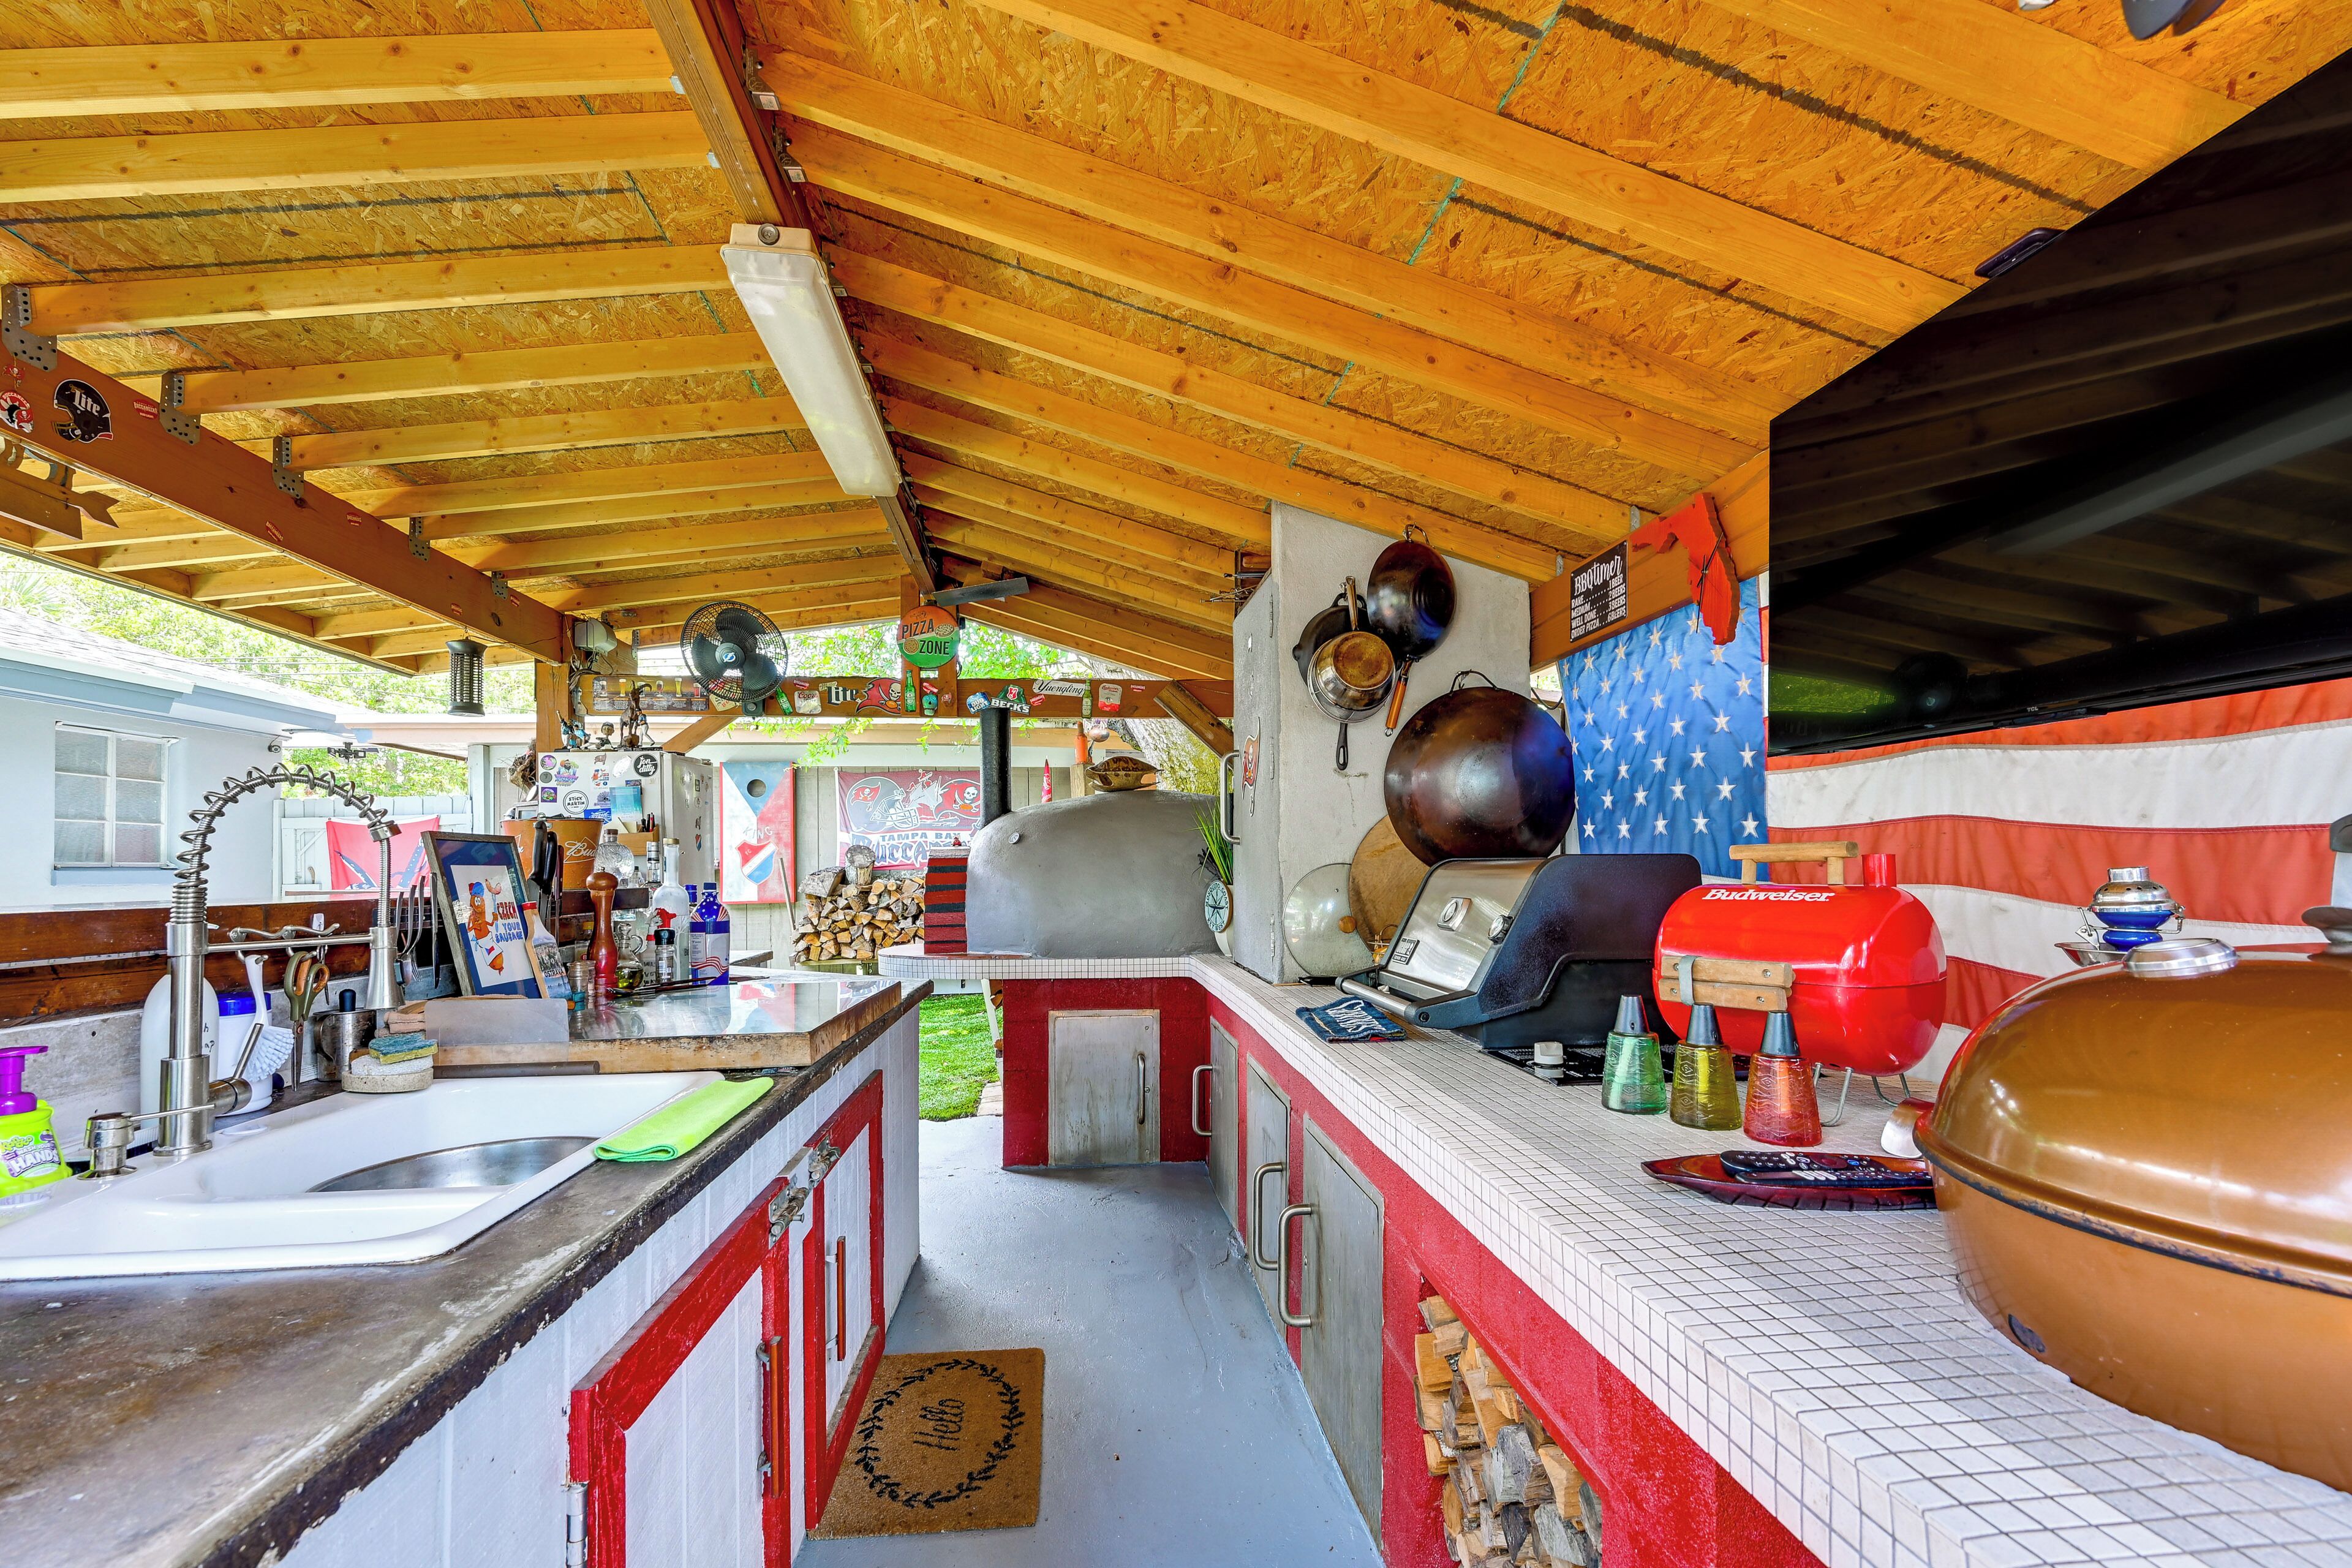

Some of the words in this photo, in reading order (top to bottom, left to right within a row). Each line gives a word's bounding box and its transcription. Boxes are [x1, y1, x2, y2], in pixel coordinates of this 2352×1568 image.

[73, 390, 100, 416] Lite
[1571, 595, 1584, 609] RARE
[1571, 601, 1591, 619] MEDIUM
[1571, 616, 1583, 629] WELL
[1584, 609, 1597, 621] DONE
[902, 619, 934, 639] PIZZA
[1571, 626, 1585, 639] ORDER
[1586, 618, 1599, 633] PIZZA
[919, 640, 949, 655] ZONE
[1034, 679, 1084, 695] Yuengling
[827, 686, 859, 706] Lite
[971, 698, 984, 707] BUD
[970, 701, 989, 712] LIGHT
[990, 698, 1030, 713] BECK'S
[639, 764, 655, 775] ditty
[743, 826, 773, 839] KING
[880, 832, 928, 842] TAMPA
[1702, 889, 1835, 902] Budweiser
[497, 902, 518, 920] CZECH
[502, 921, 521, 930] YOUR
[495, 930, 524, 943] SAUSAGE
[544, 968, 565, 978] OSTRAVA
[9, 1148, 60, 1174] HANDS
[913, 1398, 965, 1451] Hello
